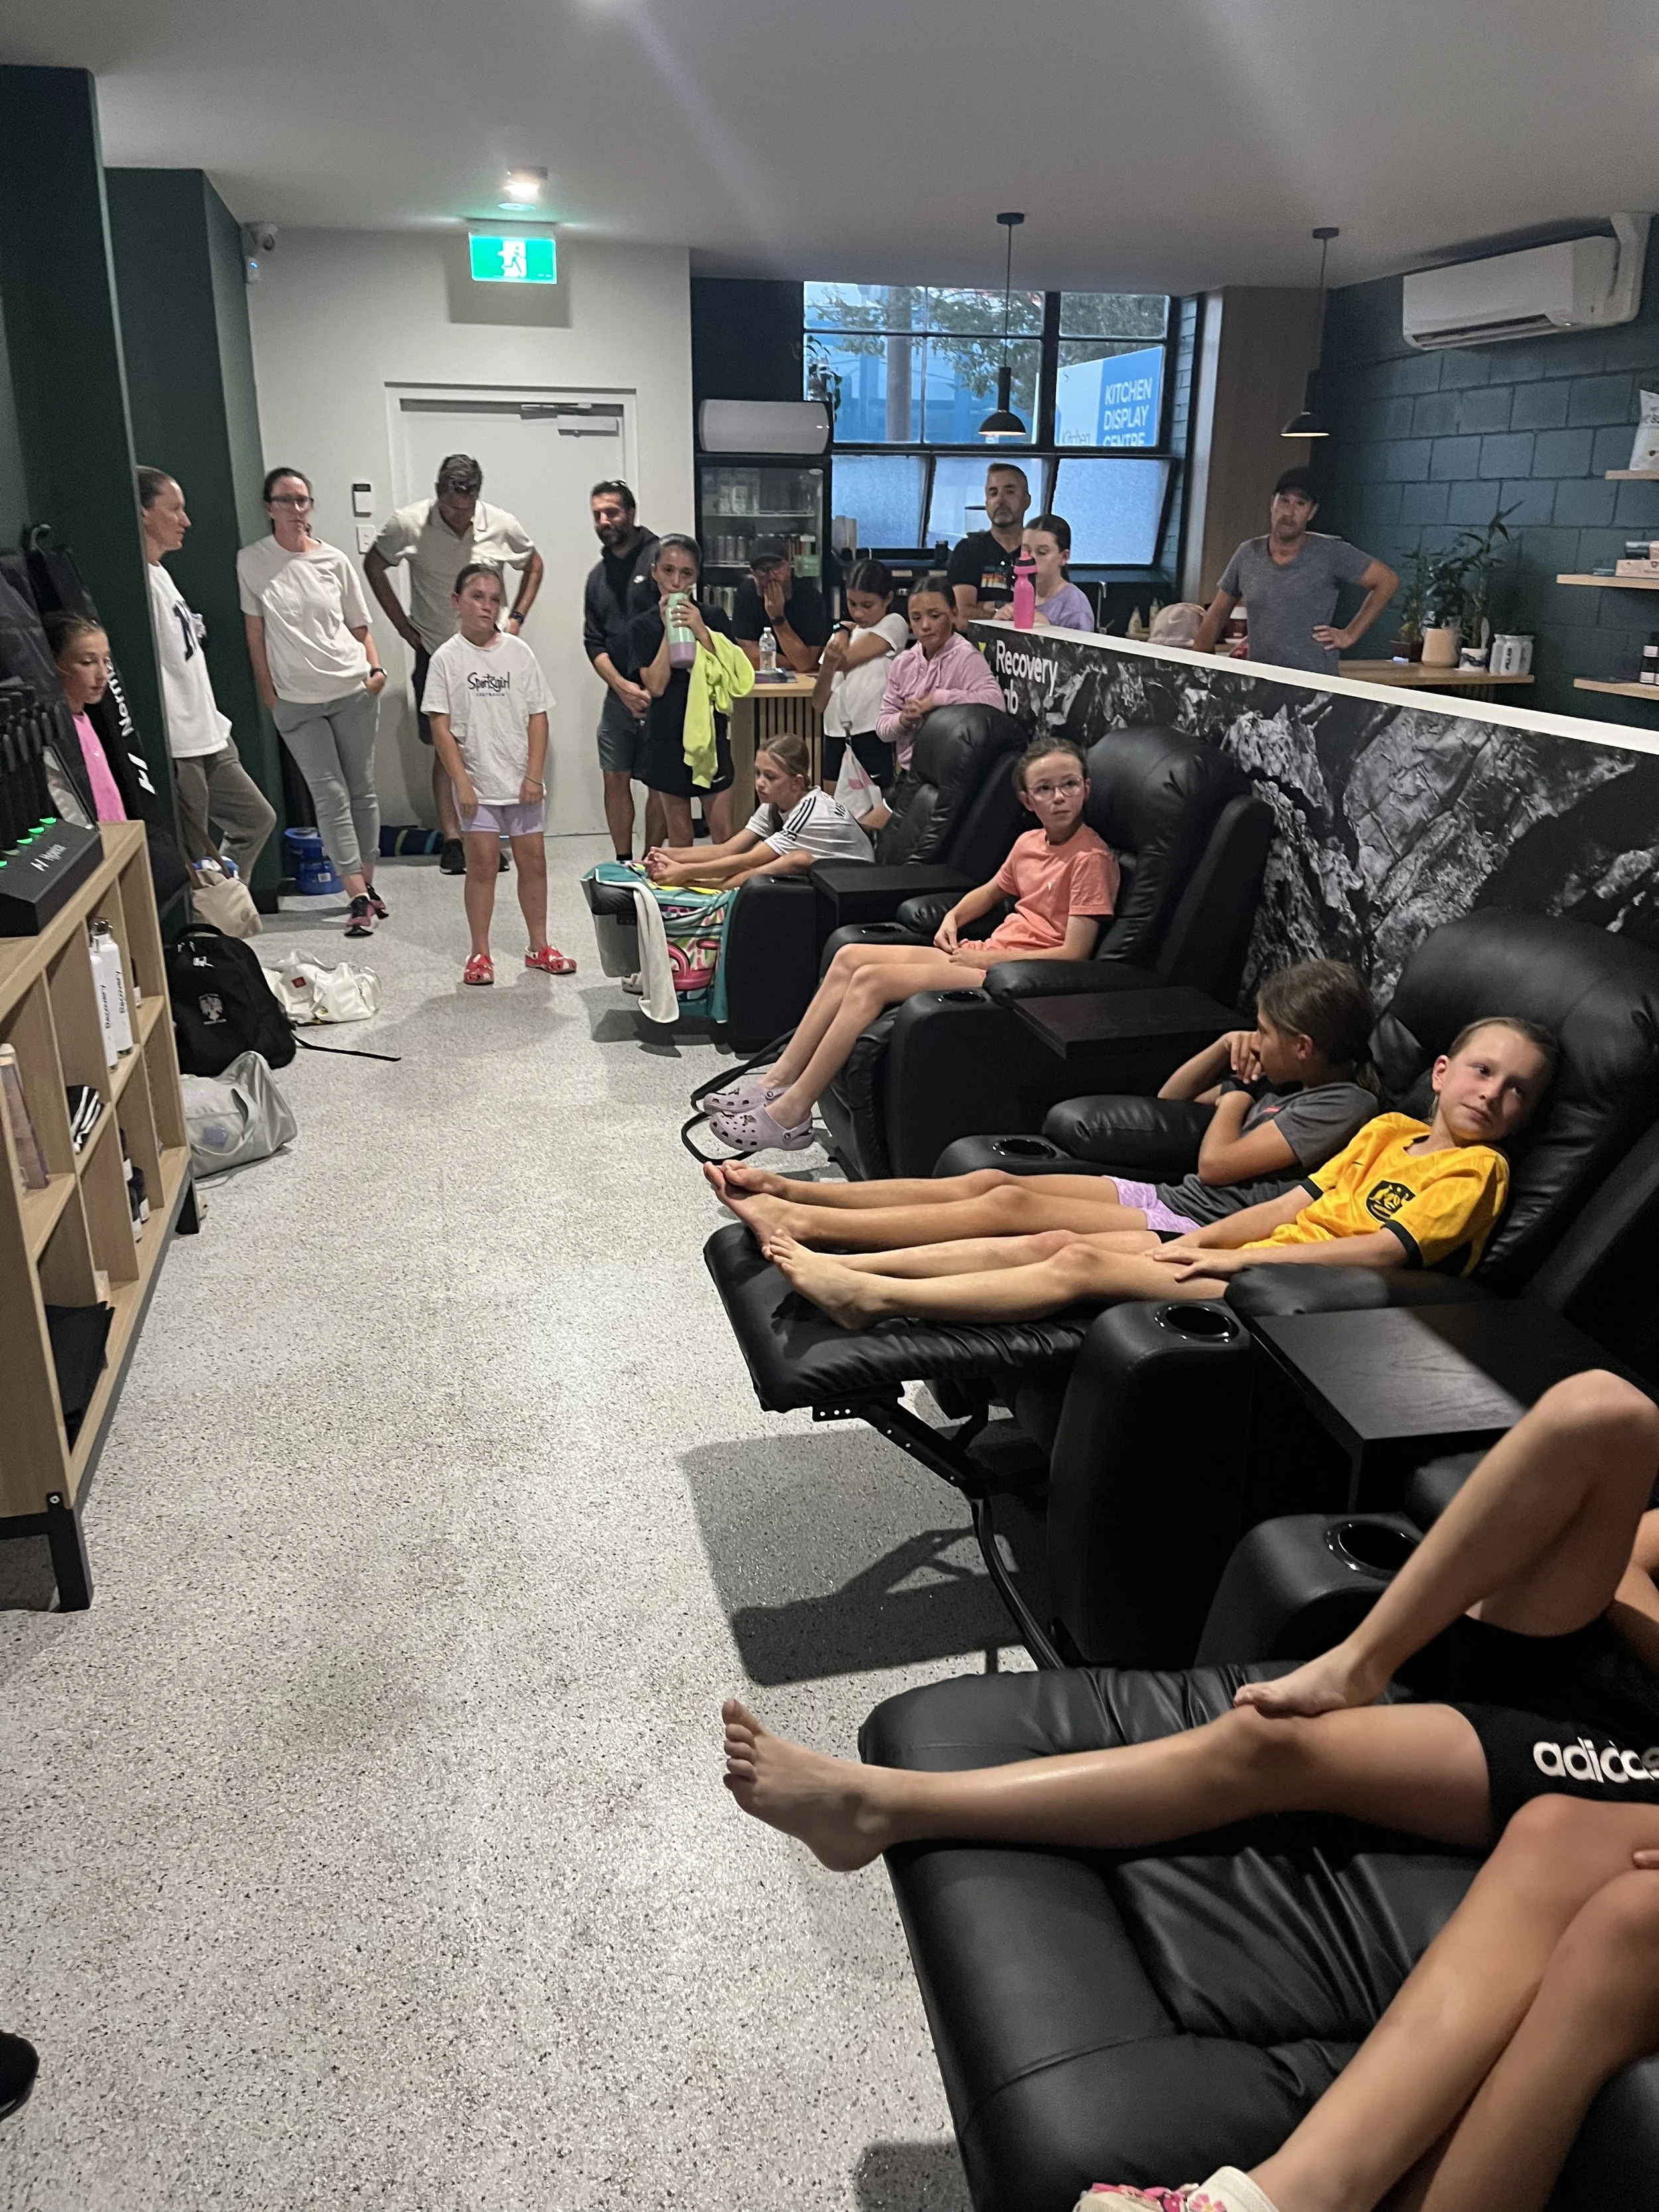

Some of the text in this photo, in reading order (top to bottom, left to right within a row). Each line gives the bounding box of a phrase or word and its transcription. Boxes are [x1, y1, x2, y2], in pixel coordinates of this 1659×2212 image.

[1104, 376, 1153, 406] KITCHEN
[1103, 404, 1150, 431] DISPLAY
[467, 671, 510, 692] Sportsgirl
[996, 639, 1058, 697] Recovery
[998, 676, 1019, 715] ab
